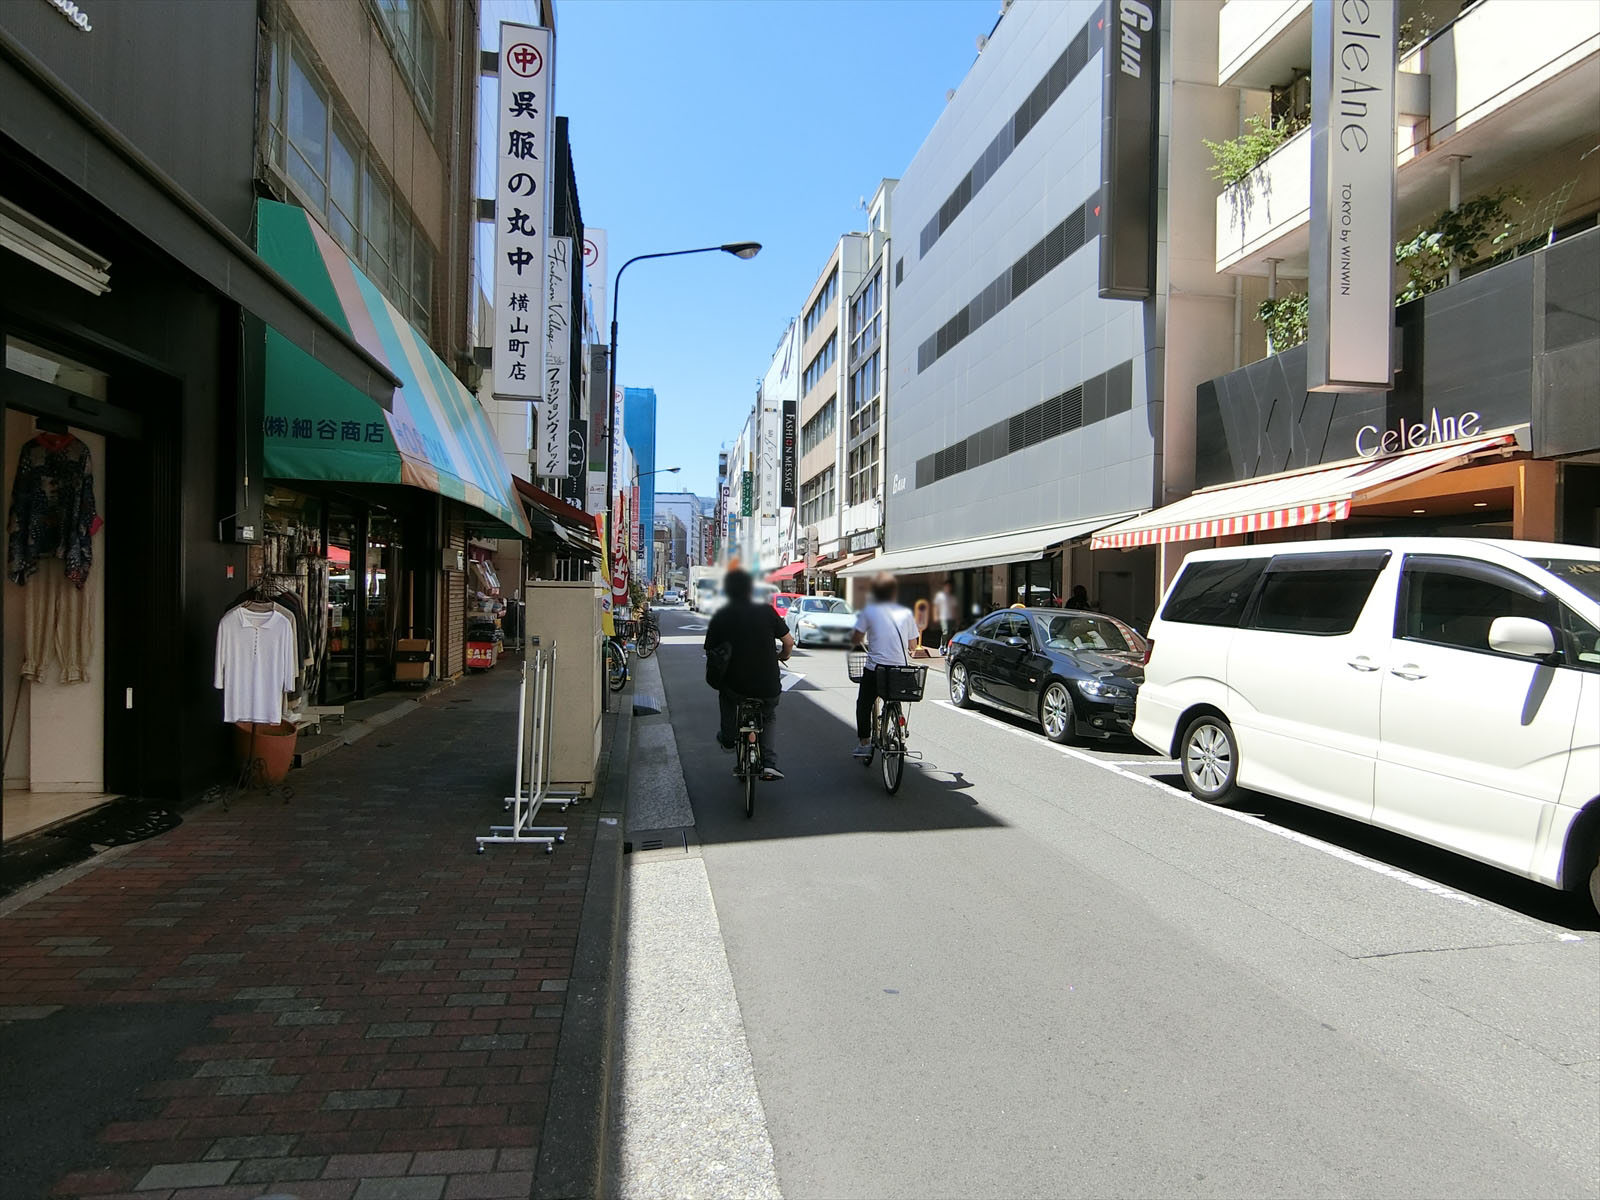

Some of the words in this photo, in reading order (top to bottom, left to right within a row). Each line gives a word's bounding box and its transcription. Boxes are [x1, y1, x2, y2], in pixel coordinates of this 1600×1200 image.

[1119, 0, 1154, 79] GAIA
[507, 90, 539, 276] 呉服の丸中
[1341, 184, 1352, 226] TOKYO
[1339, 230, 1352, 243] by
[1340, 245, 1351, 296] WINWIN
[508, 292, 531, 381] 横山町店
[785, 414, 796, 453] FASHION
[1355, 407, 1482, 459] CeleAne
[784, 455, 794, 494] MESSAGE
[467, 648, 492, 661] SALE
